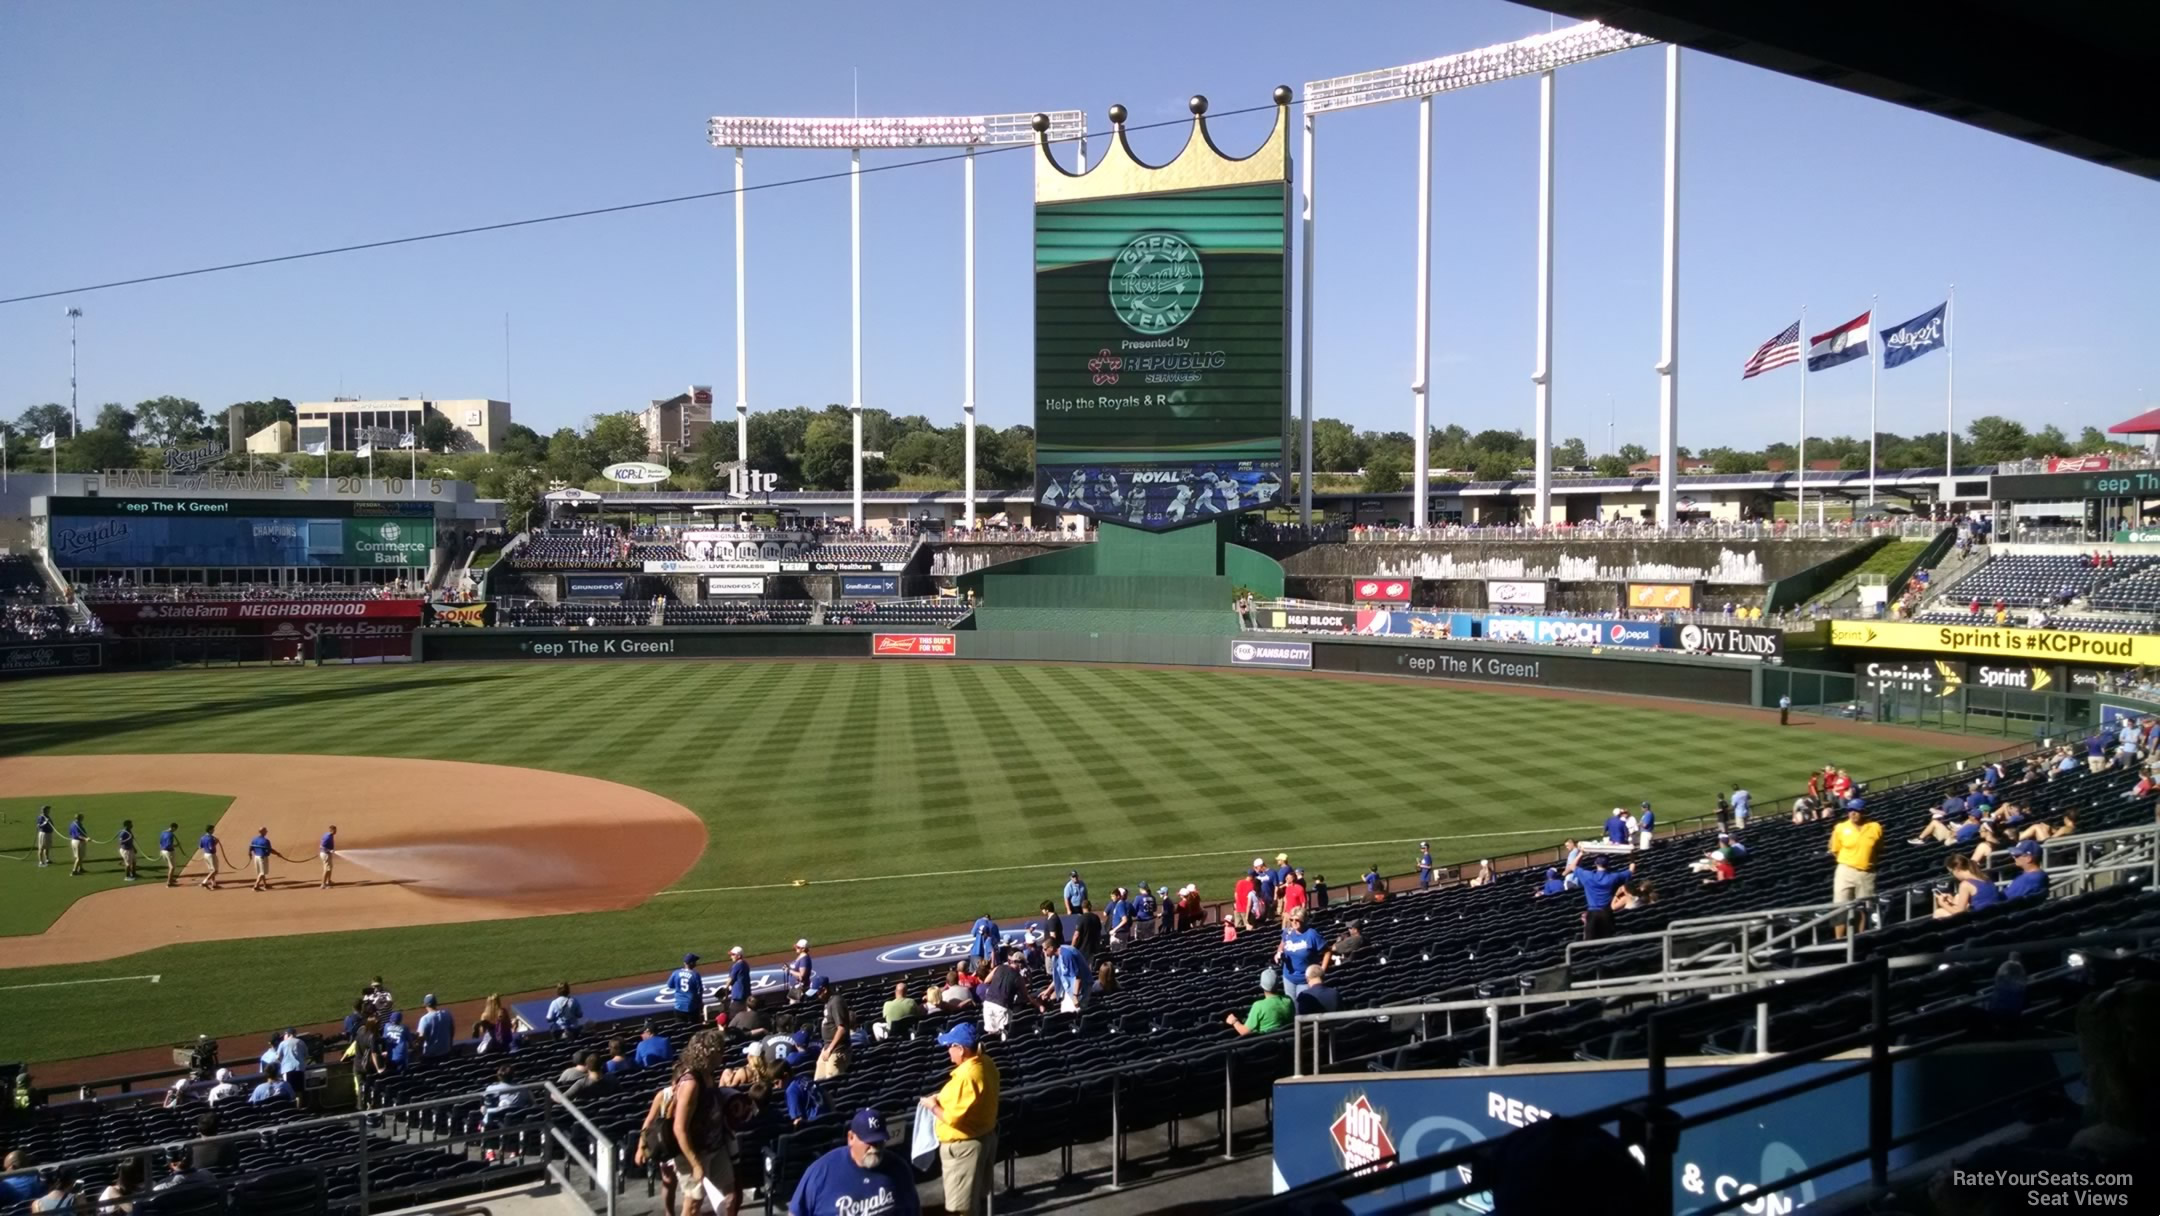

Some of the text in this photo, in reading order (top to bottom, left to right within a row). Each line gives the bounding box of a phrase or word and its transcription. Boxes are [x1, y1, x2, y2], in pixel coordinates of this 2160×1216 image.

[1123, 237, 1189, 265] GREEN
[1121, 258, 1192, 303] Royals
[1127, 303, 1185, 330] TEAM
[1121, 337, 1190, 350] Presented by
[1124, 350, 1225, 372] REPUBLIC
[1145, 371, 1202, 383] SERVICES
[1046, 399, 1073, 412] Help
[1076, 398, 1095, 409] the
[1098, 396, 1140, 411] Royals
[1143, 395, 1153, 406] &
[163, 440, 227, 472] Royals
[103, 468, 443, 495] HALL of FAME 20 10 5
[614, 468, 643, 480] KCP&L
[1131, 471, 1180, 483] ROYAL
[727, 465, 778, 500] Lite
[2095, 478, 2131, 494] eep
[122, 502, 229, 512] eep The K Green!
[57, 519, 130, 555] Royals
[355, 540, 426, 552] Commerce
[739, 546, 757, 560] Lite
[374, 552, 408, 564] Bank
[510, 561, 544, 569] RGOSY
[547, 561, 582, 569] CASINO
[584, 561, 614, 569] HOTEL
[815, 563, 838, 572] Quality
[838, 562, 872, 571] Healthcare
[239, 603, 366, 617] NEIGHBORHOOD
[435, 610, 482, 621] SONIC
[1288, 615, 1343, 626] H&R BLOCK
[1488, 620, 1602, 643] PEPSI PORCH
[1626, 629, 1649, 641] pepsi
[530, 639, 675, 658] eep The K Green!
[1832, 628, 2133, 657] Sprint Sprint is #KCProud
[1256, 647, 1290, 659] KANSAS
[1290, 648, 1309, 660] CITY
[1404, 655, 1540, 678] eep The K Green!
[1866, 662, 1932, 694] Sprint
[1979, 666, 2027, 688] Sprint
[2072, 674, 2097, 686] Sprint
[680, 978, 689, 992] 5
[1345, 1102, 1381, 1146] HOT
[1681, 1163, 1806, 1216] & CON
[835, 1186, 895, 1216] Royals
